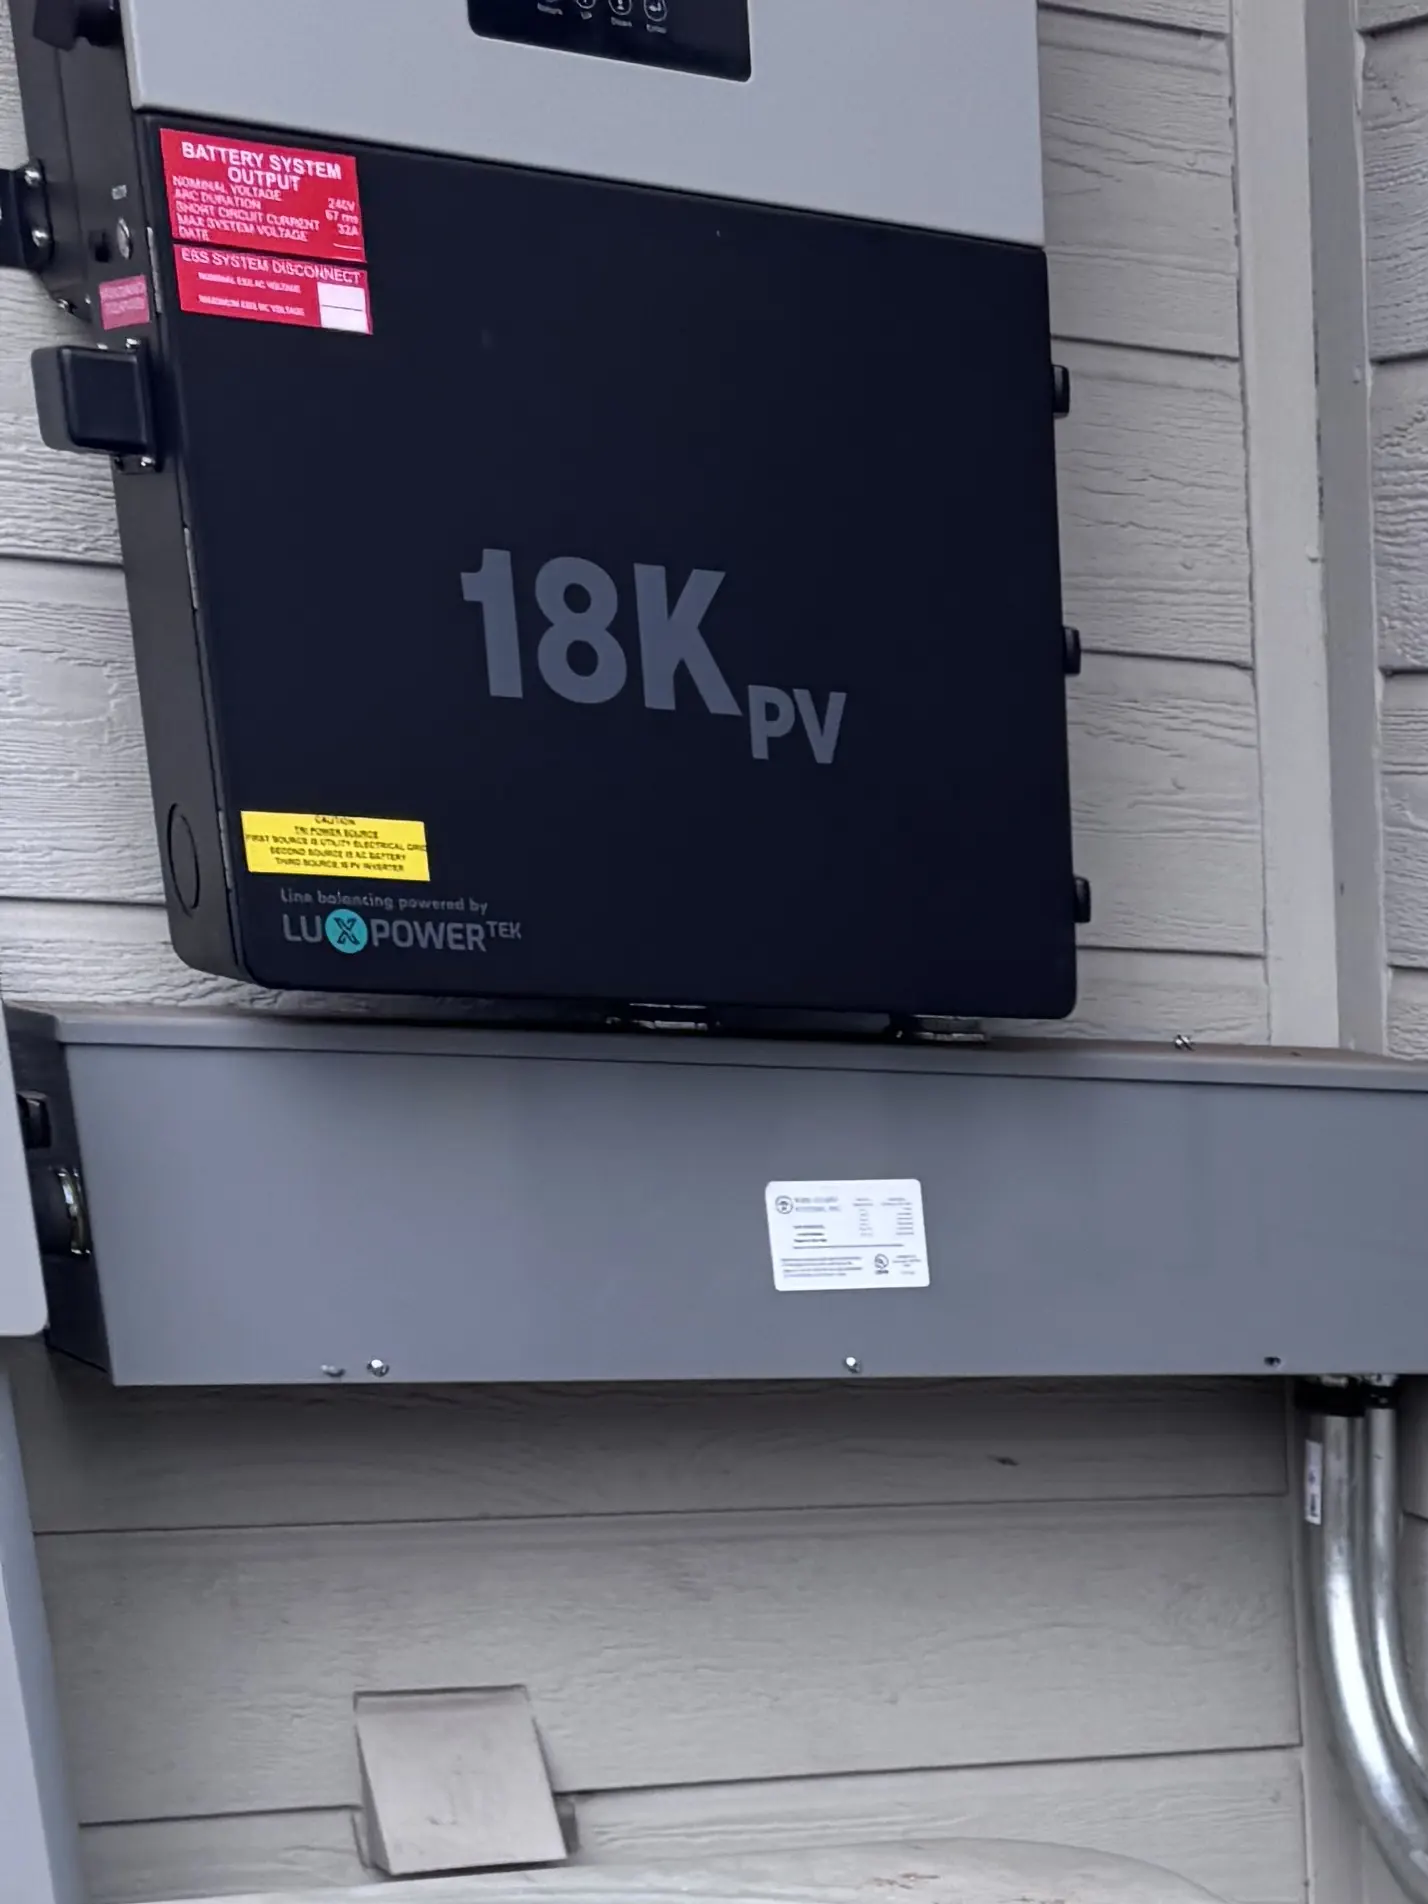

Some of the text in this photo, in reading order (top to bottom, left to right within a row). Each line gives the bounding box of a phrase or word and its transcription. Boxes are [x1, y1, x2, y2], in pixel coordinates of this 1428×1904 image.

[182, 141, 341, 180] BATTERY SYSTEM
[227, 167, 300, 191] OUTPUT
[201, 192, 261, 209] DURATION
[230, 184, 282, 202] VOLTAGE
[176, 200, 320, 231] SHORT CIRCUIT CURRENT
[207, 218, 254, 233] SYSTEM
[256, 225, 308, 242] VOLTAGE
[212, 252, 268, 272] SYSTEM
[272, 260, 362, 284] DISCONNECT
[280, 887, 488, 916] Line balancing powered by
